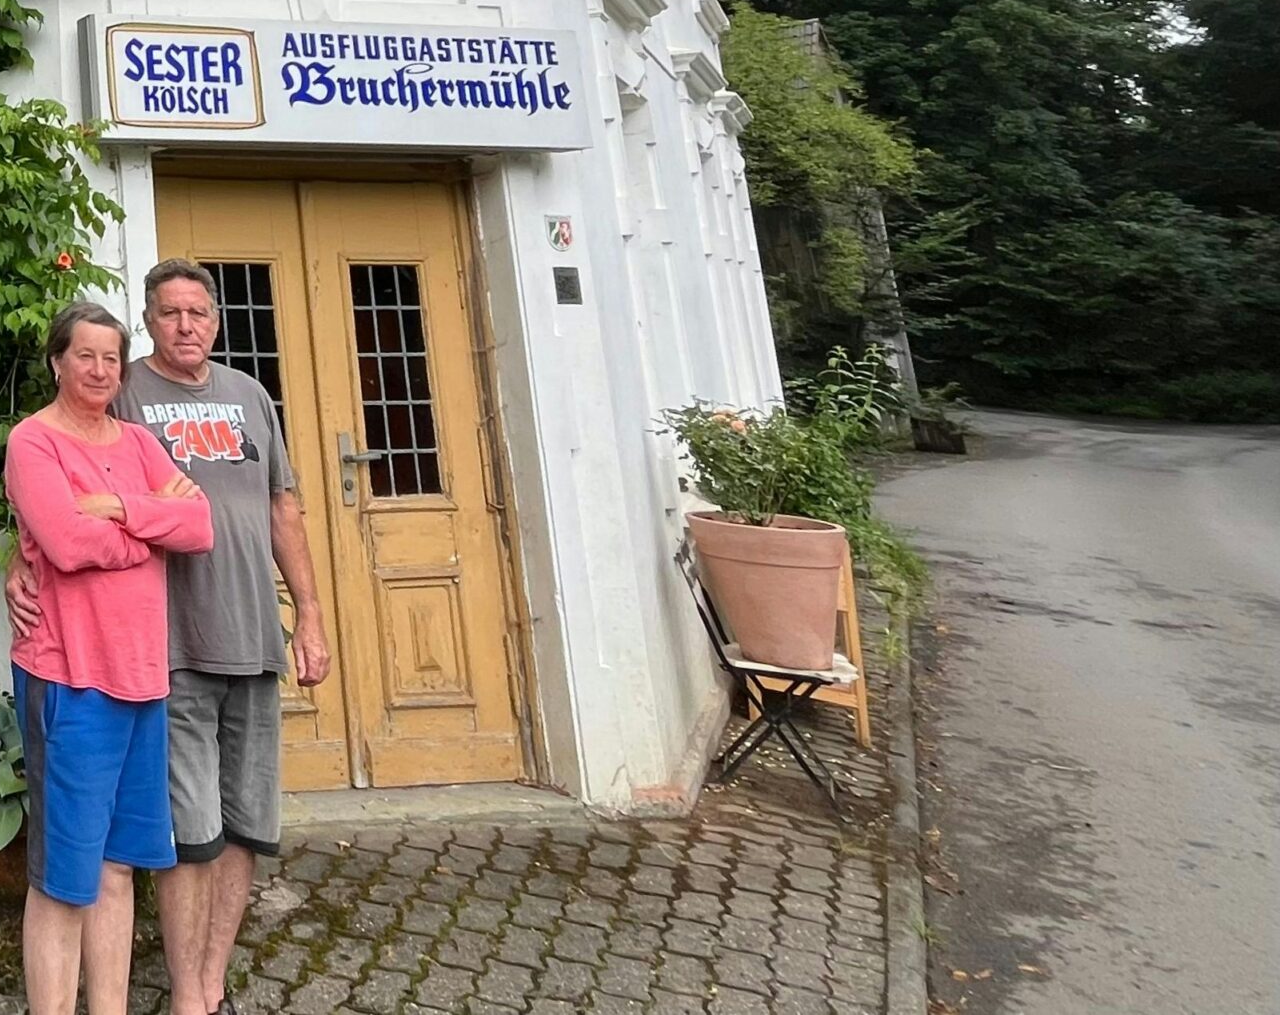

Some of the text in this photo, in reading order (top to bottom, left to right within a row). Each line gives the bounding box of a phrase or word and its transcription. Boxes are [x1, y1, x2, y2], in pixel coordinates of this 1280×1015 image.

[124, 37, 244, 86] SESTER
[282, 32, 559, 66] AUSFLUGGASTSTÄTTE
[144, 85, 230, 115] KÖLSCH
[281, 61, 572, 116] Bruchermühle
[142, 402, 246, 424] BRENNPUNKT
